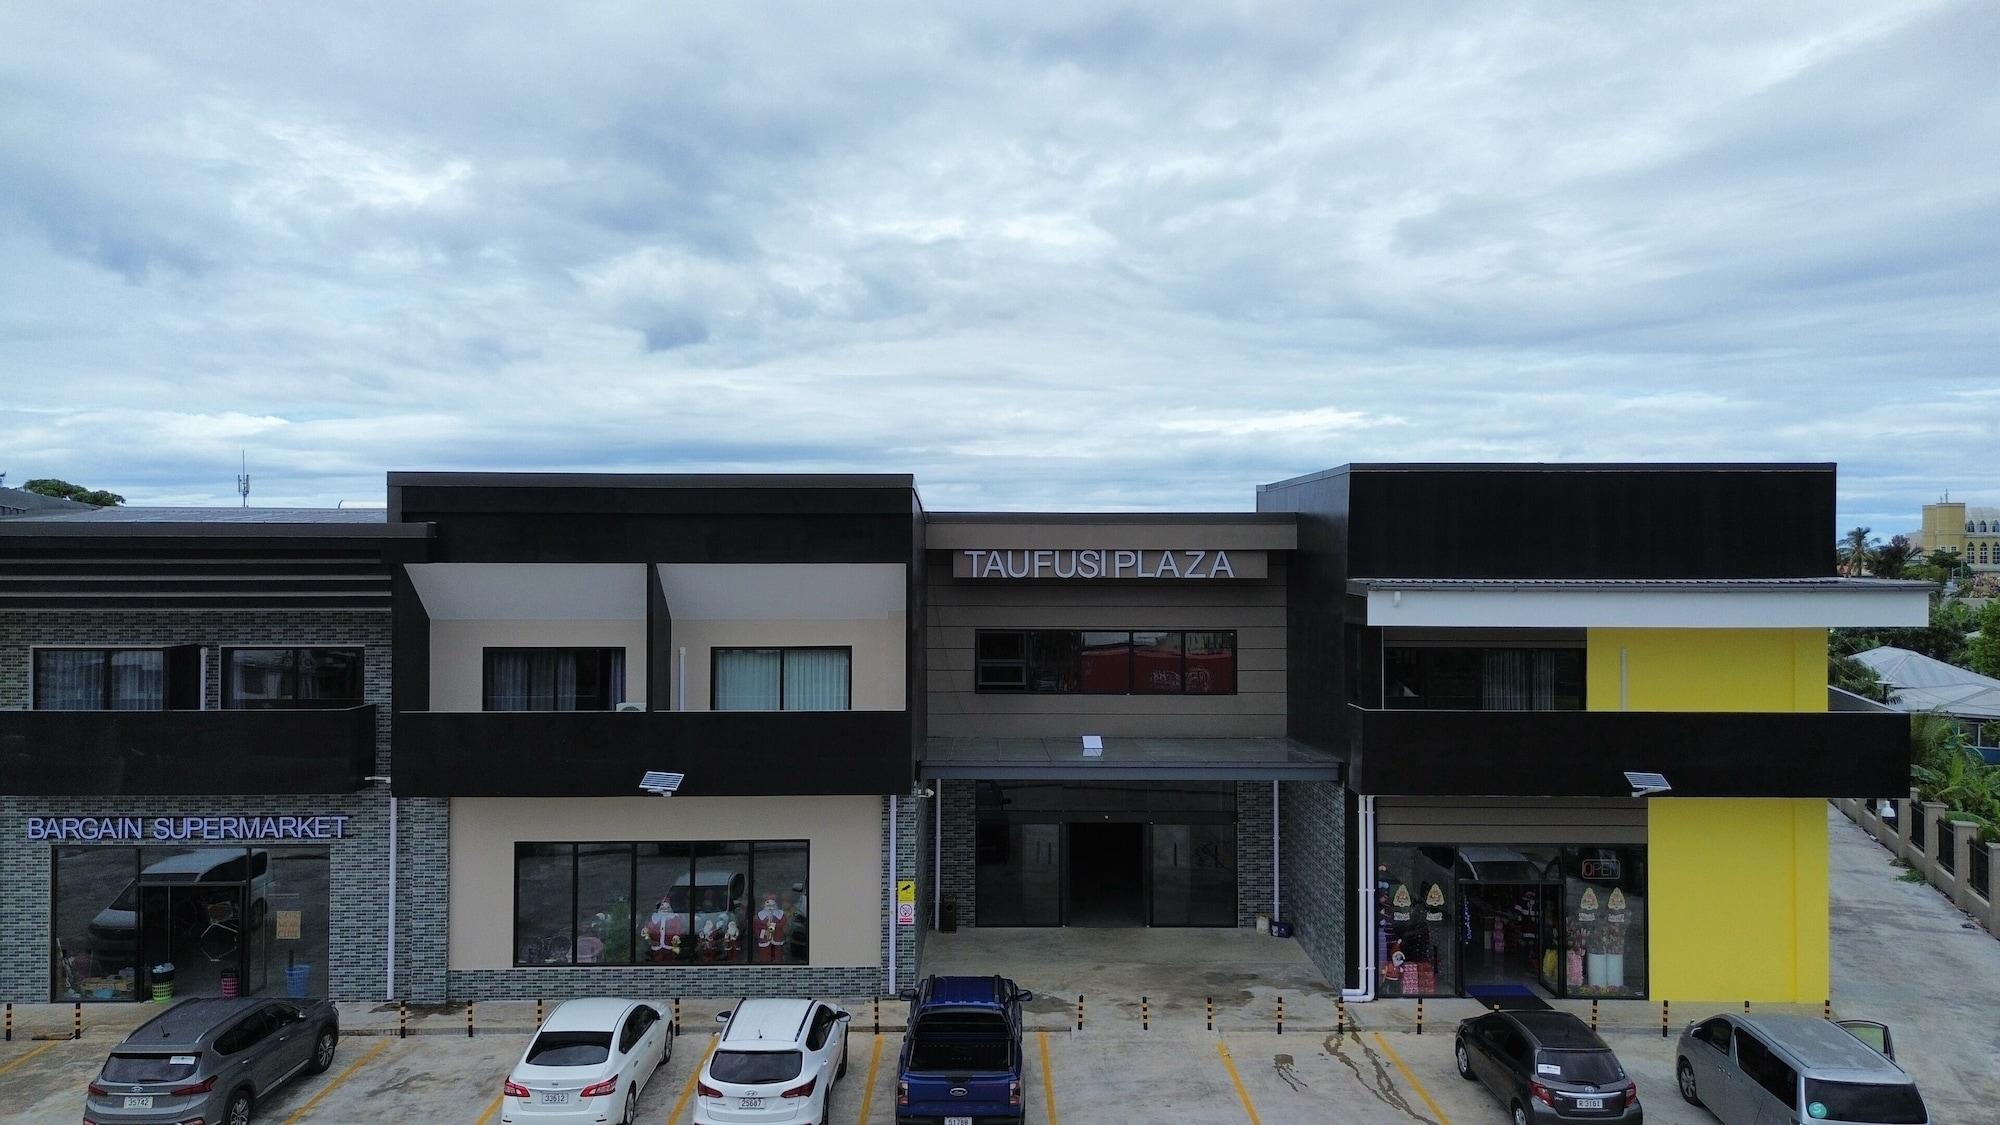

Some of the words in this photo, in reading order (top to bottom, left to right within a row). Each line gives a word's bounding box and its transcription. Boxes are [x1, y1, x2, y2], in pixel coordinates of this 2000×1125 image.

[964, 550, 1106, 579] TAUFUSI
[1114, 550, 1235, 579] PLAZA
[28, 817, 142, 840] BARGAIN
[153, 816, 349, 840] SUPERMARKET
[1583, 862, 1618, 877] OPEN
